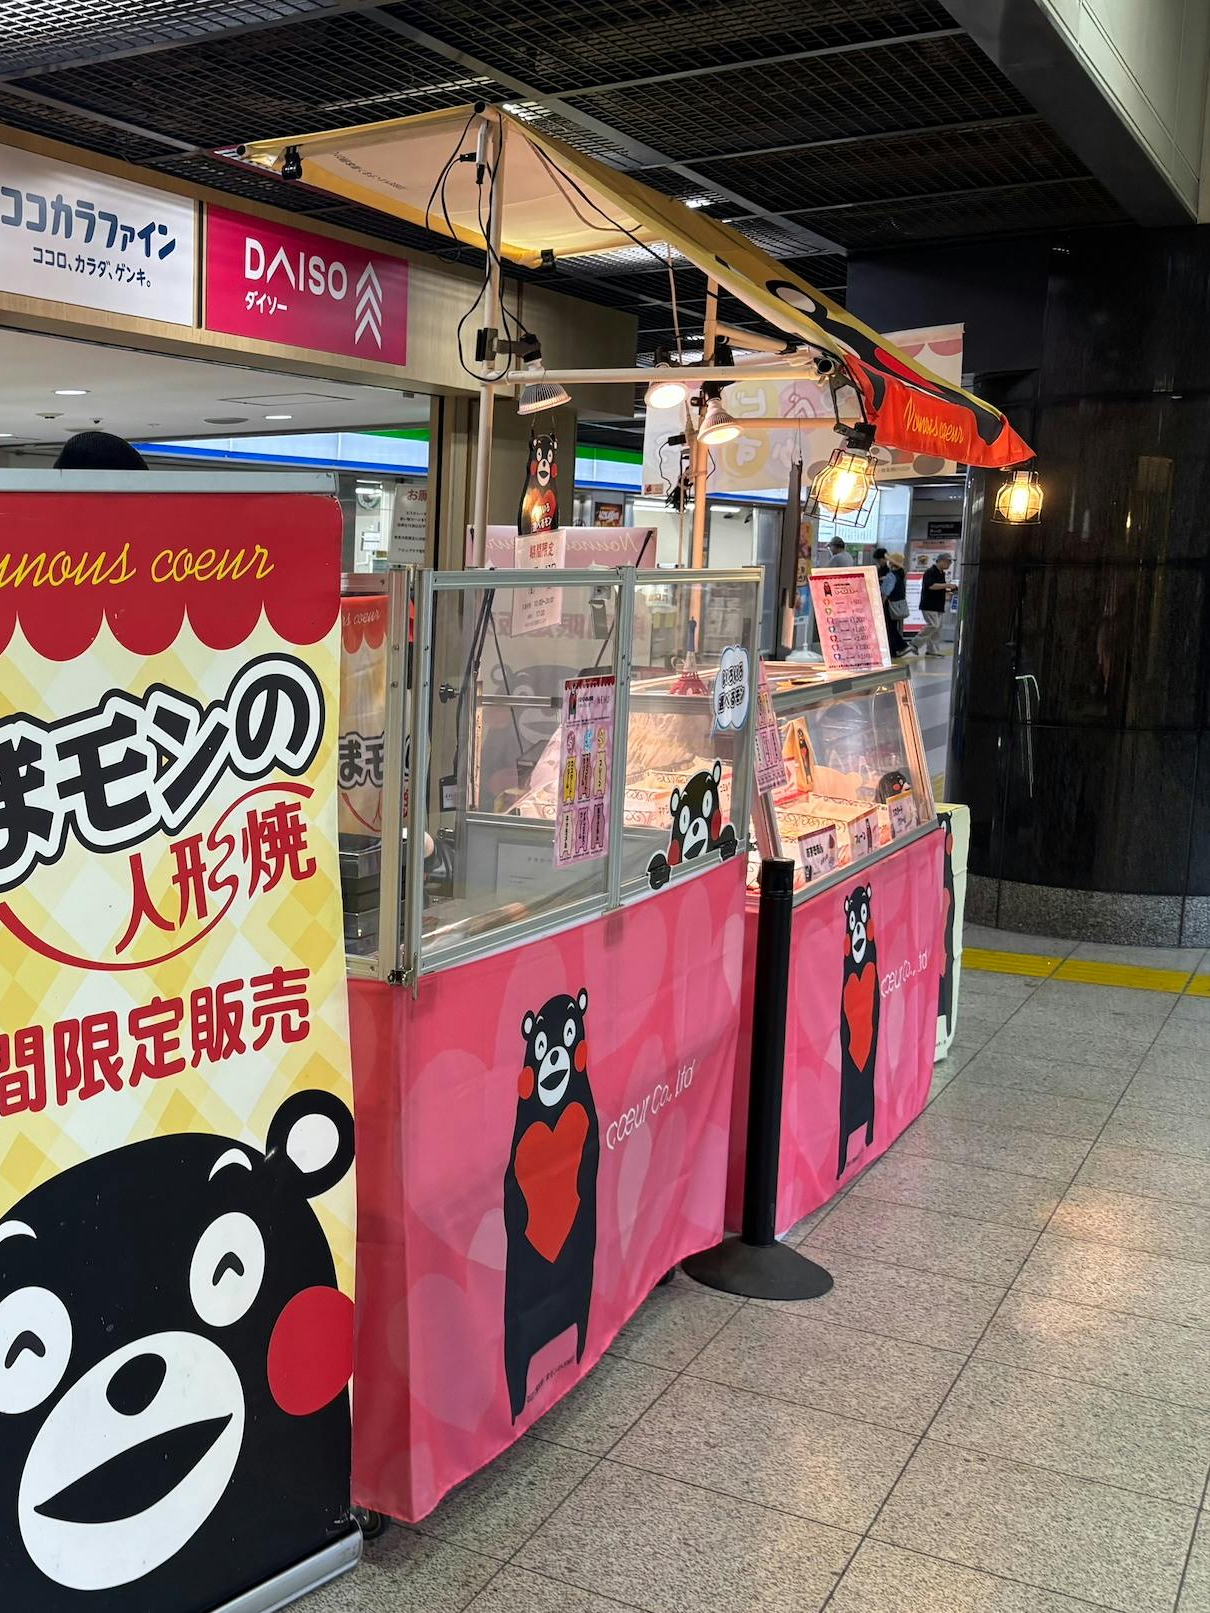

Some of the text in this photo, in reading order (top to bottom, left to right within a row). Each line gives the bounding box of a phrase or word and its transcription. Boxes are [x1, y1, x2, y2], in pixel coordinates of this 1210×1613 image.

[0, 186, 176, 261] ココカラファイン
[32, 246, 152, 288] ココロ、カラダ、ゲンキ。
[244, 236, 348, 300] DAISO
[244, 290, 288, 316] ダイソー
[150, 542, 274, 584] coeur
[116, 799, 318, 956] 人形焼
